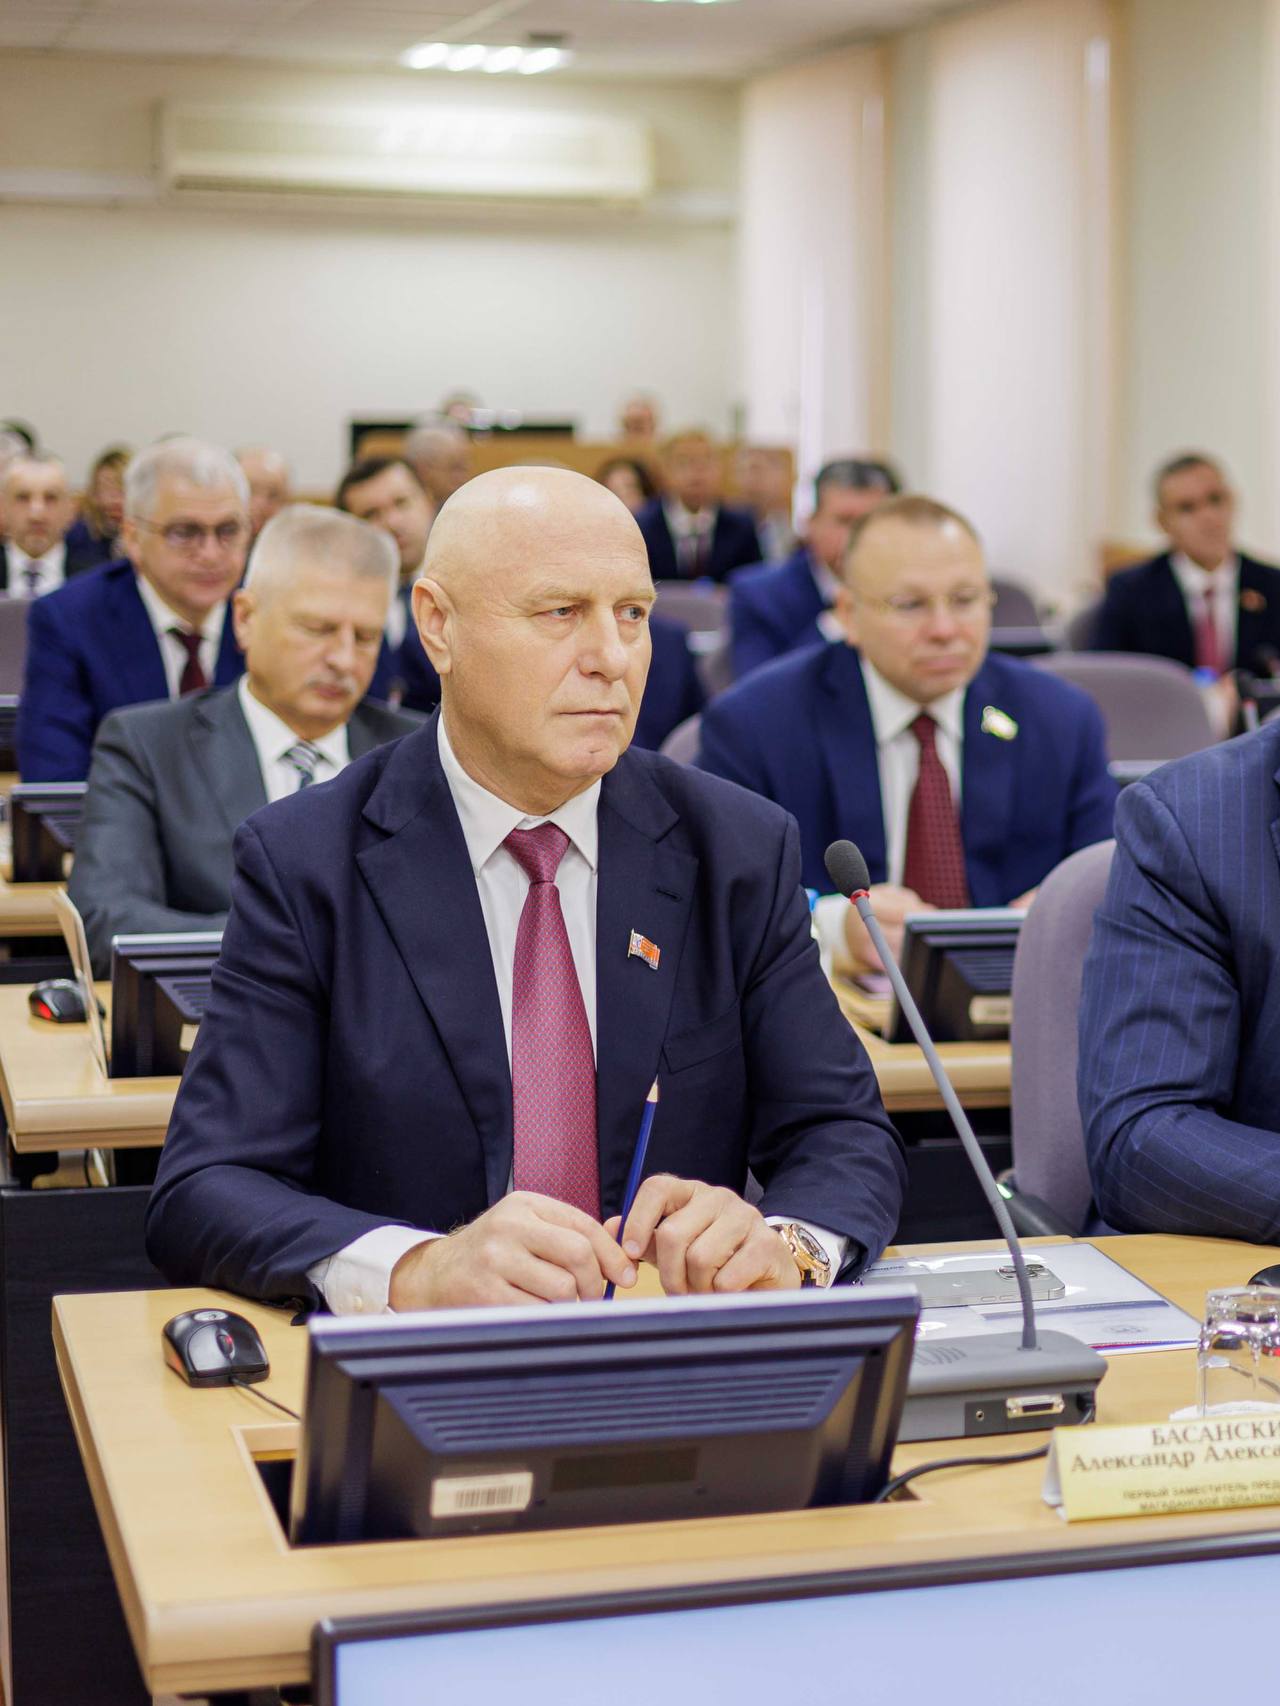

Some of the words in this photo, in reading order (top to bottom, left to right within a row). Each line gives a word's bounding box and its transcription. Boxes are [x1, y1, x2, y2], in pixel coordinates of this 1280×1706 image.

[1072, 1446, 1196, 1472] Александр
[1122, 1487, 1169, 1500] ПЕРВЫЙ
[1172, 1482, 1249, 1496] ЗАМЕСТИТЕЛЬ
